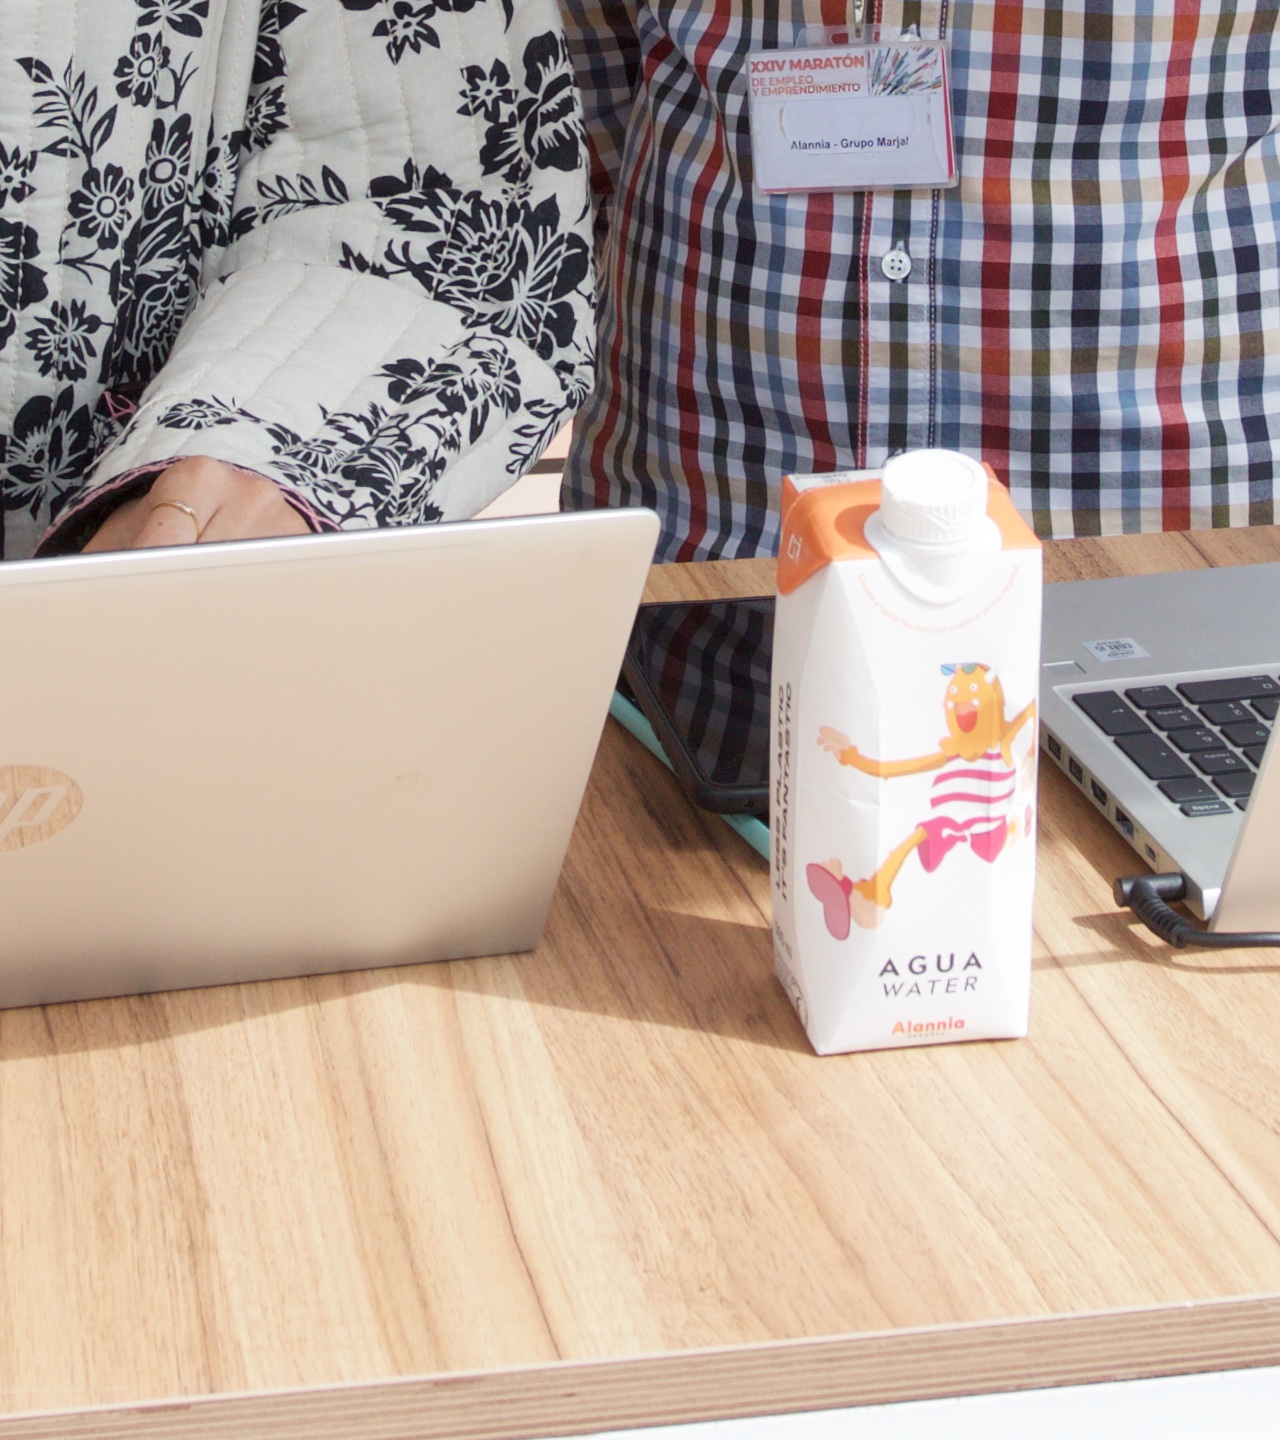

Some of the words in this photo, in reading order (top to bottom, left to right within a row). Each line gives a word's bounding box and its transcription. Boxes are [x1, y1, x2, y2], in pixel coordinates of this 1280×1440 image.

[751, 58, 787, 74] XXIV
[788, 52, 866, 72] MARATÓN
[752, 76, 767, 87] DE
[769, 74, 814, 86] EMPLEO
[752, 86, 760, 97] Y
[761, 82, 861, 97] EMPRENDIMIENTO
[790, 138, 831, 151] Alannia
[840, 137, 874, 152] Grupo
[876, 135, 910, 150] Marjal
[878, 951, 983, 978] AGUA
[883, 975, 979, 998] WATER
[891, 1016, 966, 1035] Alannia
